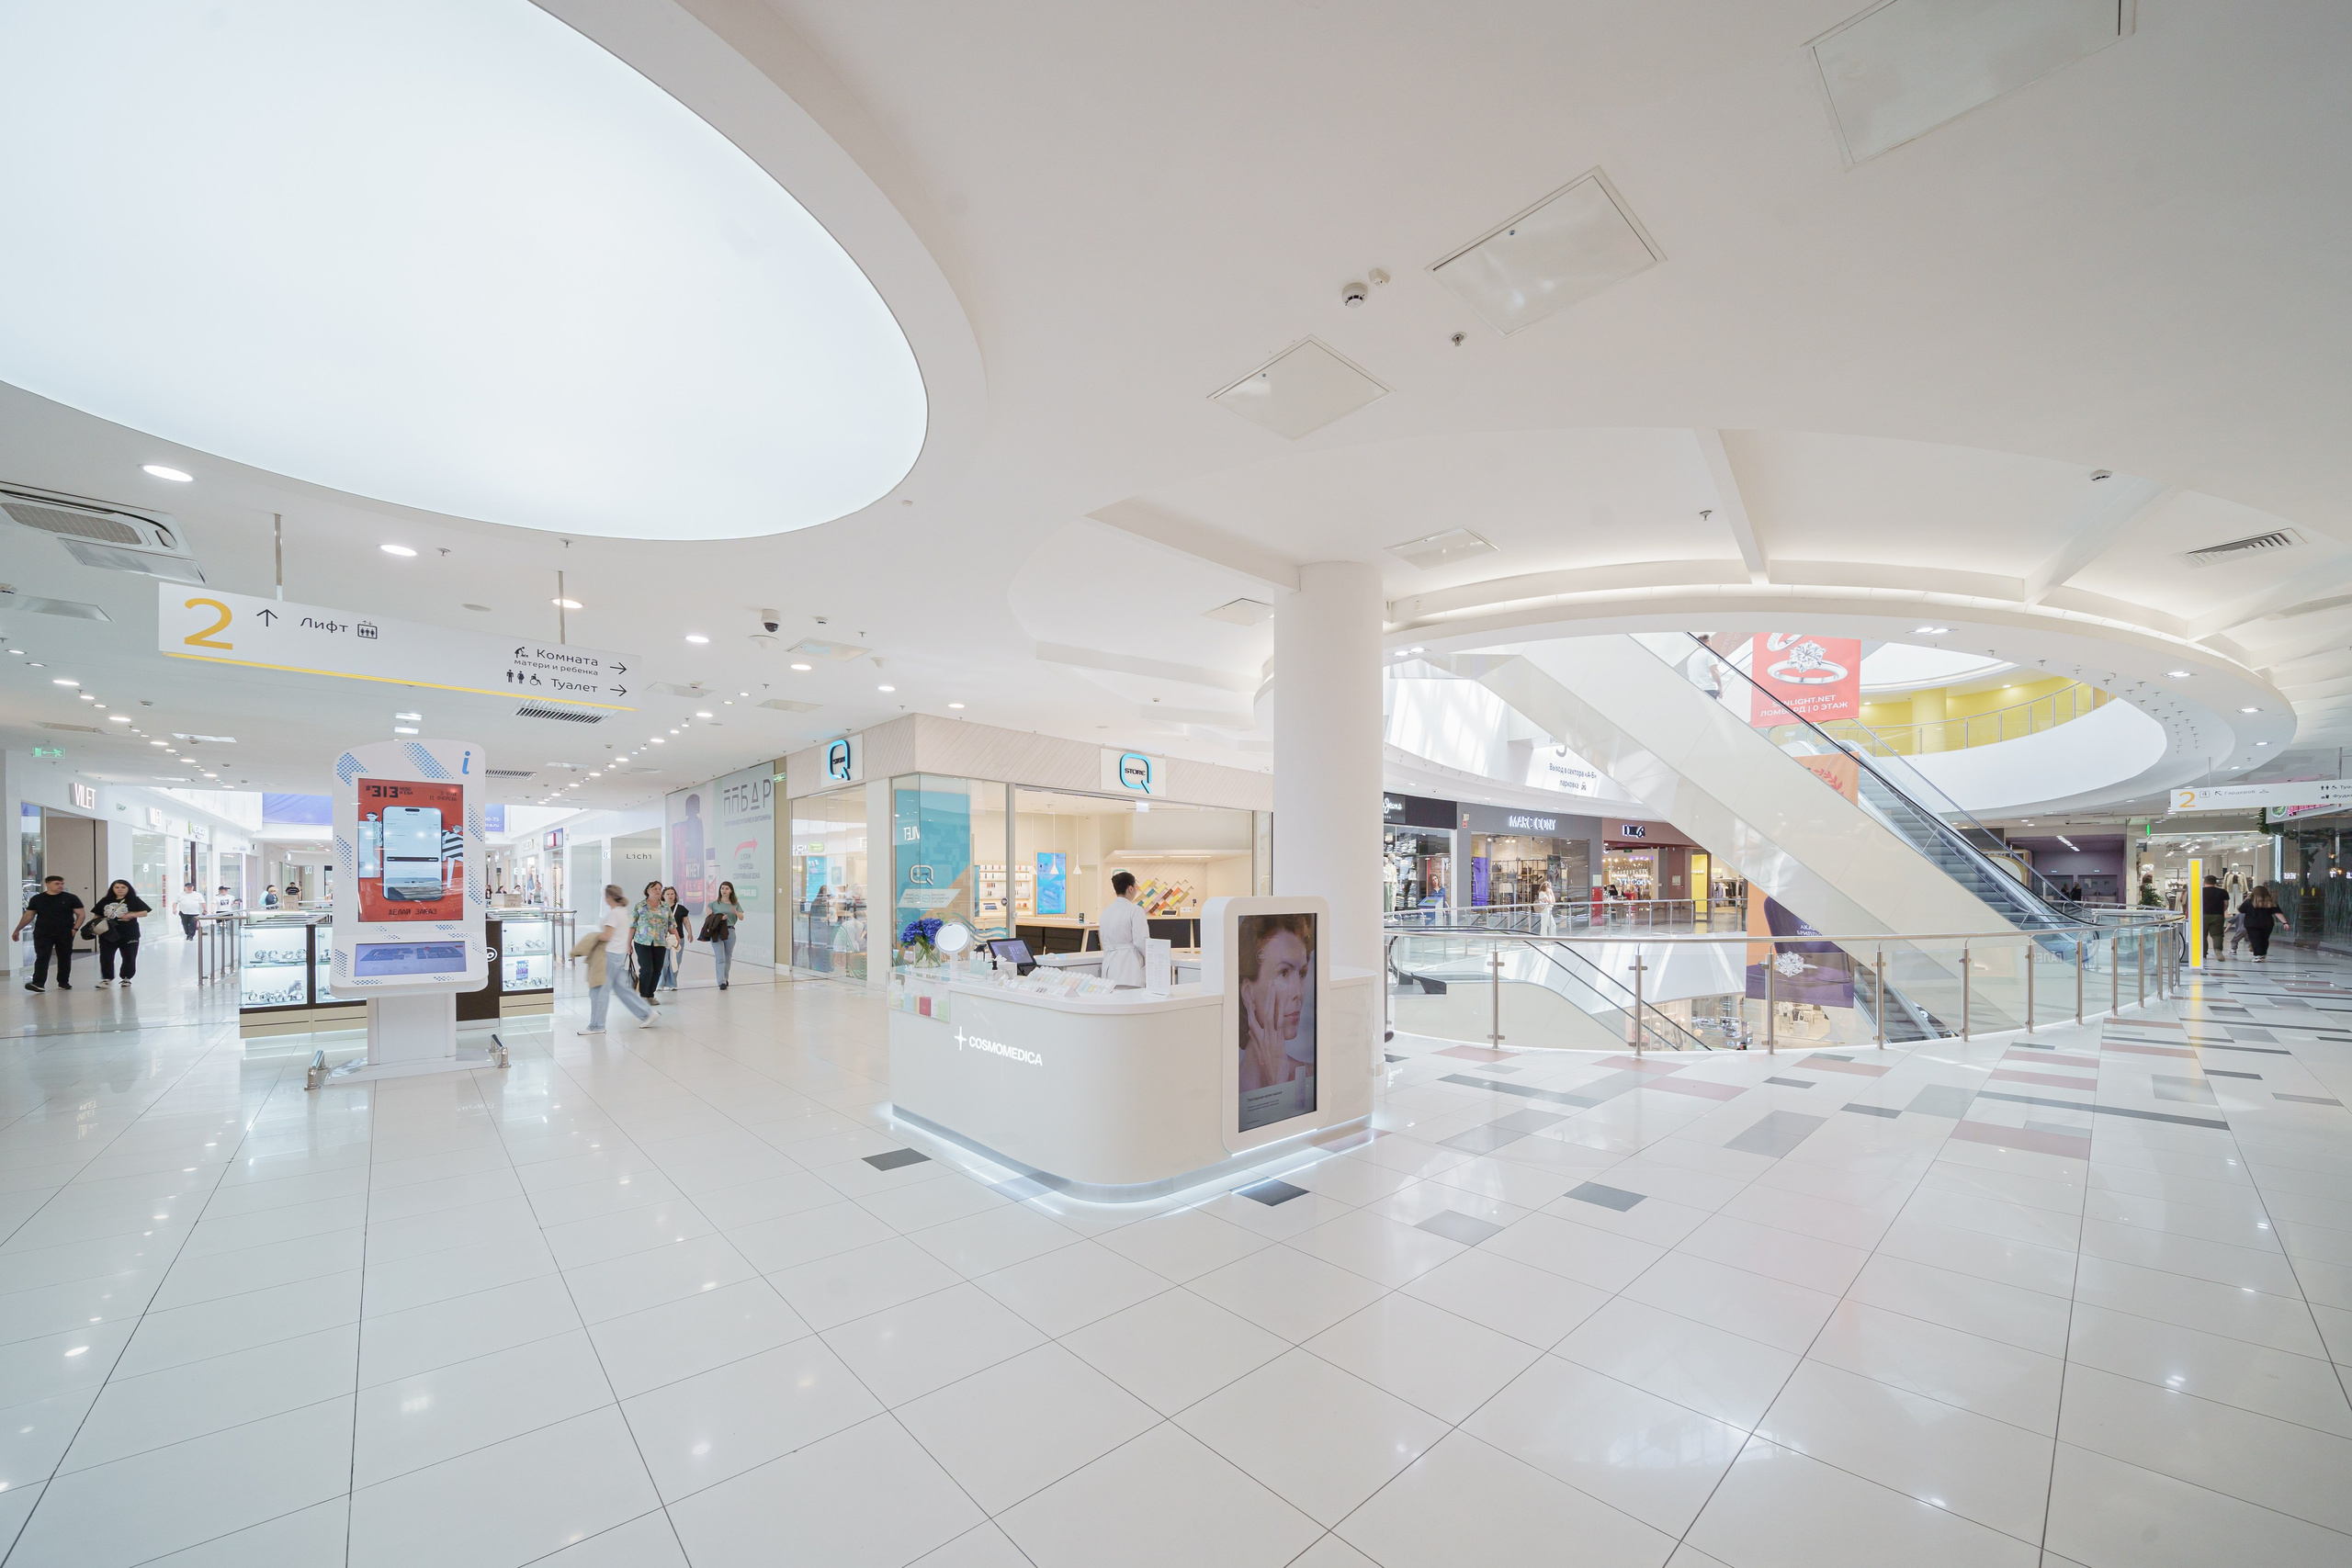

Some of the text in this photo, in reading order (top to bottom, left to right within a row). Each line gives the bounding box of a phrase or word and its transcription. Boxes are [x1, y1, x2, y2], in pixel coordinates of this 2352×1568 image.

[185, 598, 233, 650] 2
[300, 617, 348, 634] Лифт
[537, 649, 599, 667] Комната
[514, 660, 550, 670] матери
[560, 666, 599, 676] ребенка
[551, 678, 599, 694] Туалет
[1771, 694, 1837, 708] SNLIGHT.NET
[1760, 705, 1806, 717] ЛОМБРД
[1821, 702, 1849, 711] ЭТАЖ
[1125, 767, 1146, 776] STORE
[1549, 762, 1564, 774] Выход
[366, 784, 399, 798] #313
[1559, 780, 1579, 788] парковка
[73, 782, 96, 810] VILET
[2178, 791, 2196, 808] 2
[1509, 815, 1557, 831] MARC CONY
[968, 1035, 1044, 1066] COSMOMEDICA
